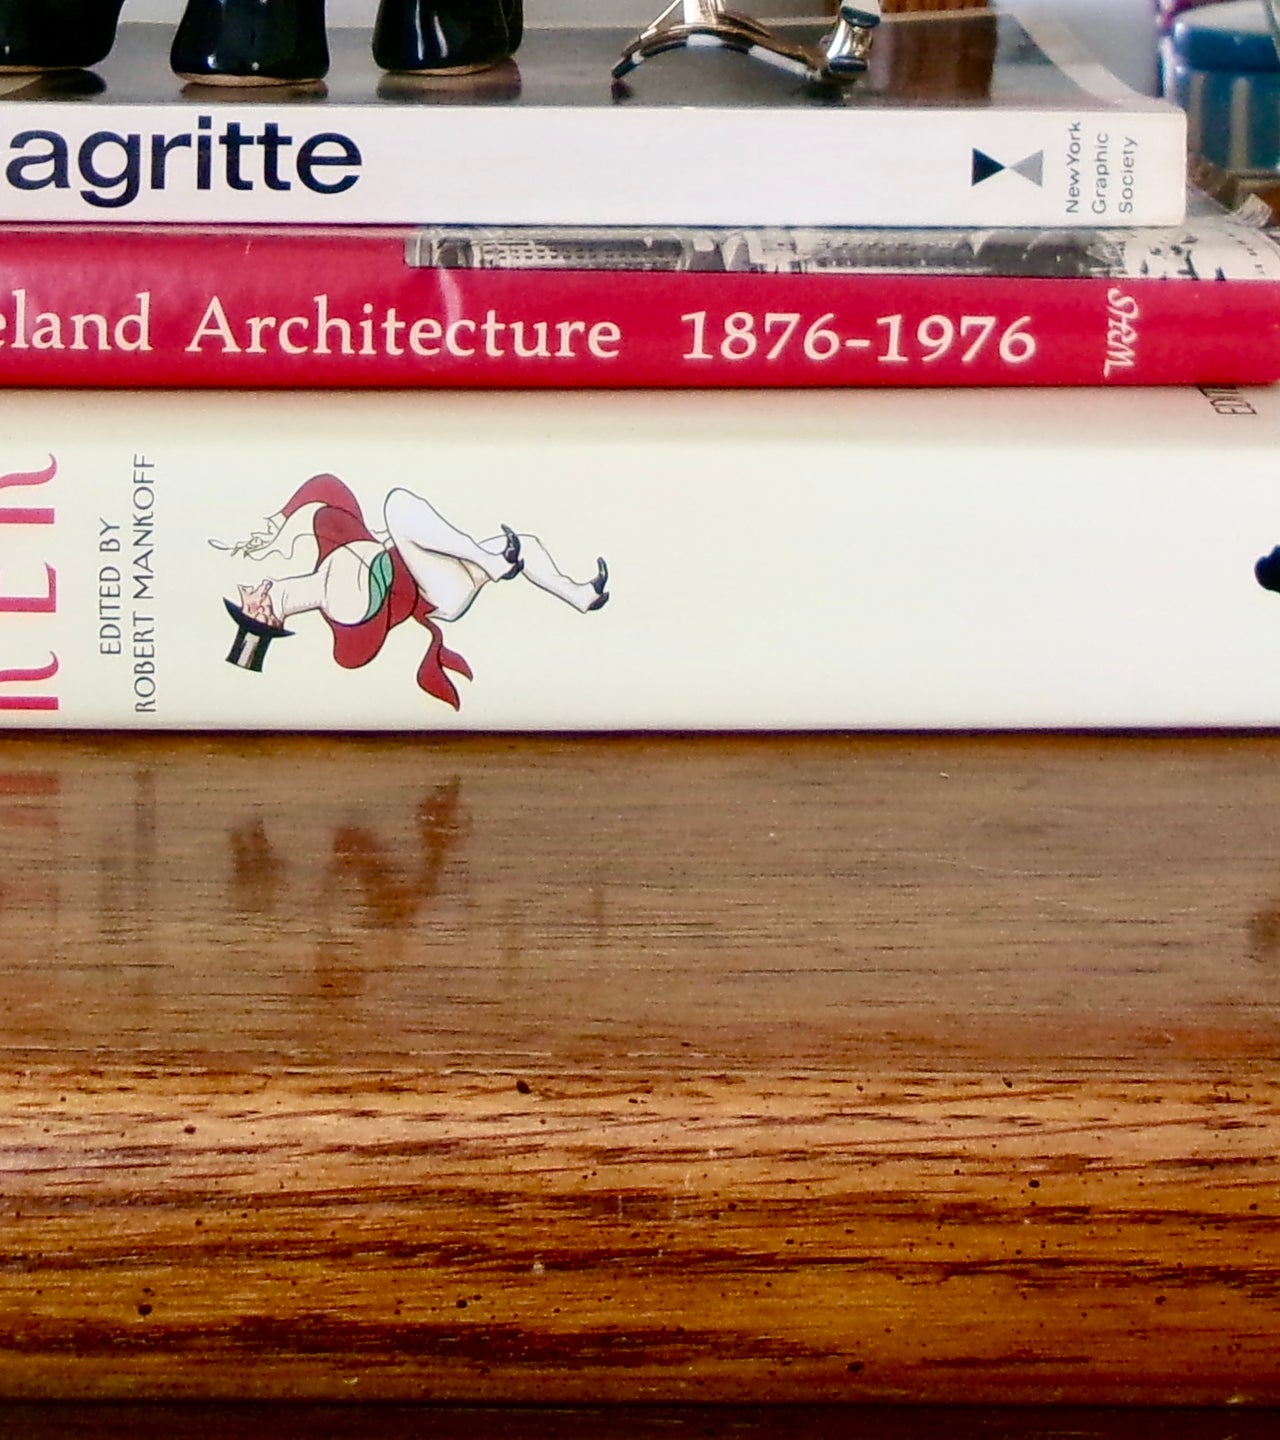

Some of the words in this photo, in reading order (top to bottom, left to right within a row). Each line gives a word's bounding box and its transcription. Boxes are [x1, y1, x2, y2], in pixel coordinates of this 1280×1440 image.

[1091, 133, 1111, 215] Graphic
[1119, 136, 1139, 214] Society
[184, 295, 622, 359] Architecture
[681, 310, 1037, 364] 1876-1976
[98, 517, 121, 552] BY
[131, 454, 155, 600] MANKOFF
[98, 566, 122, 655] EDITED
[132, 610, 157, 713] ROBERT
